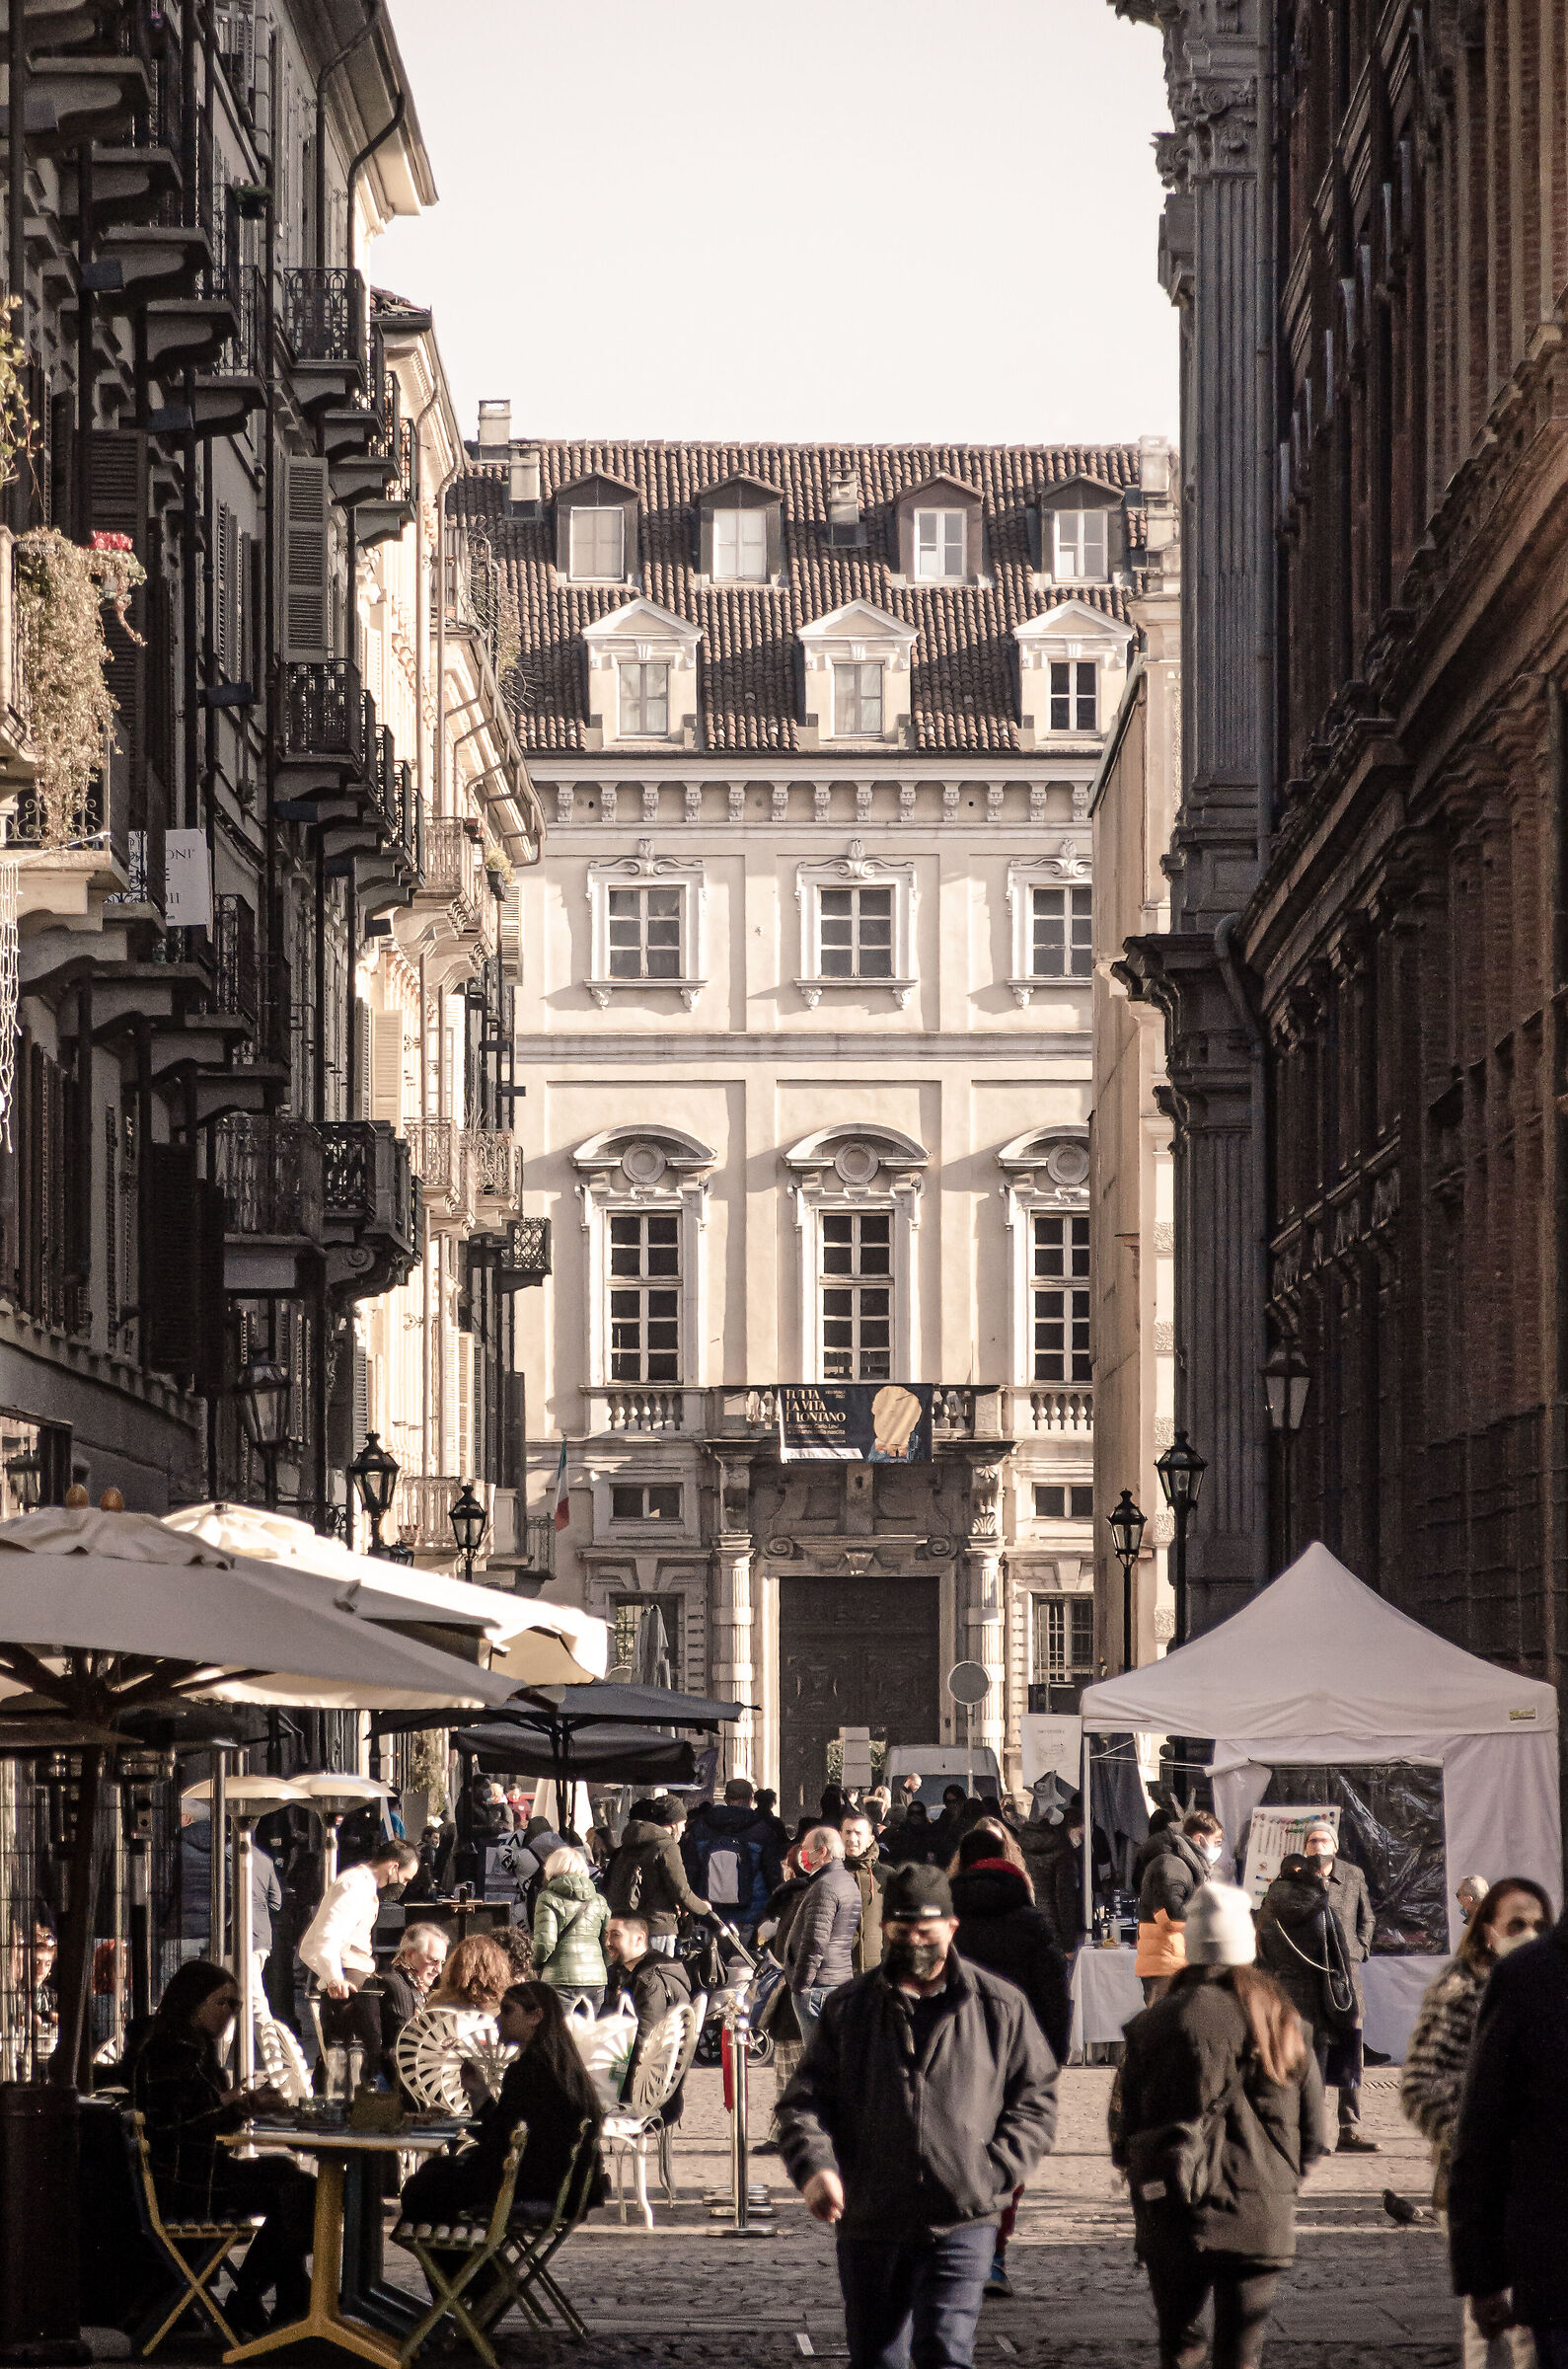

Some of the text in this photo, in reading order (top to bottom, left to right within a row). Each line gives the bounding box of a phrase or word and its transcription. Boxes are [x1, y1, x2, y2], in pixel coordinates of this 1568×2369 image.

[784, 1389, 820, 1400] TUTTA
[785, 1400, 826, 1412] LA VITA
[795, 1412, 847, 1422] LONTANO
